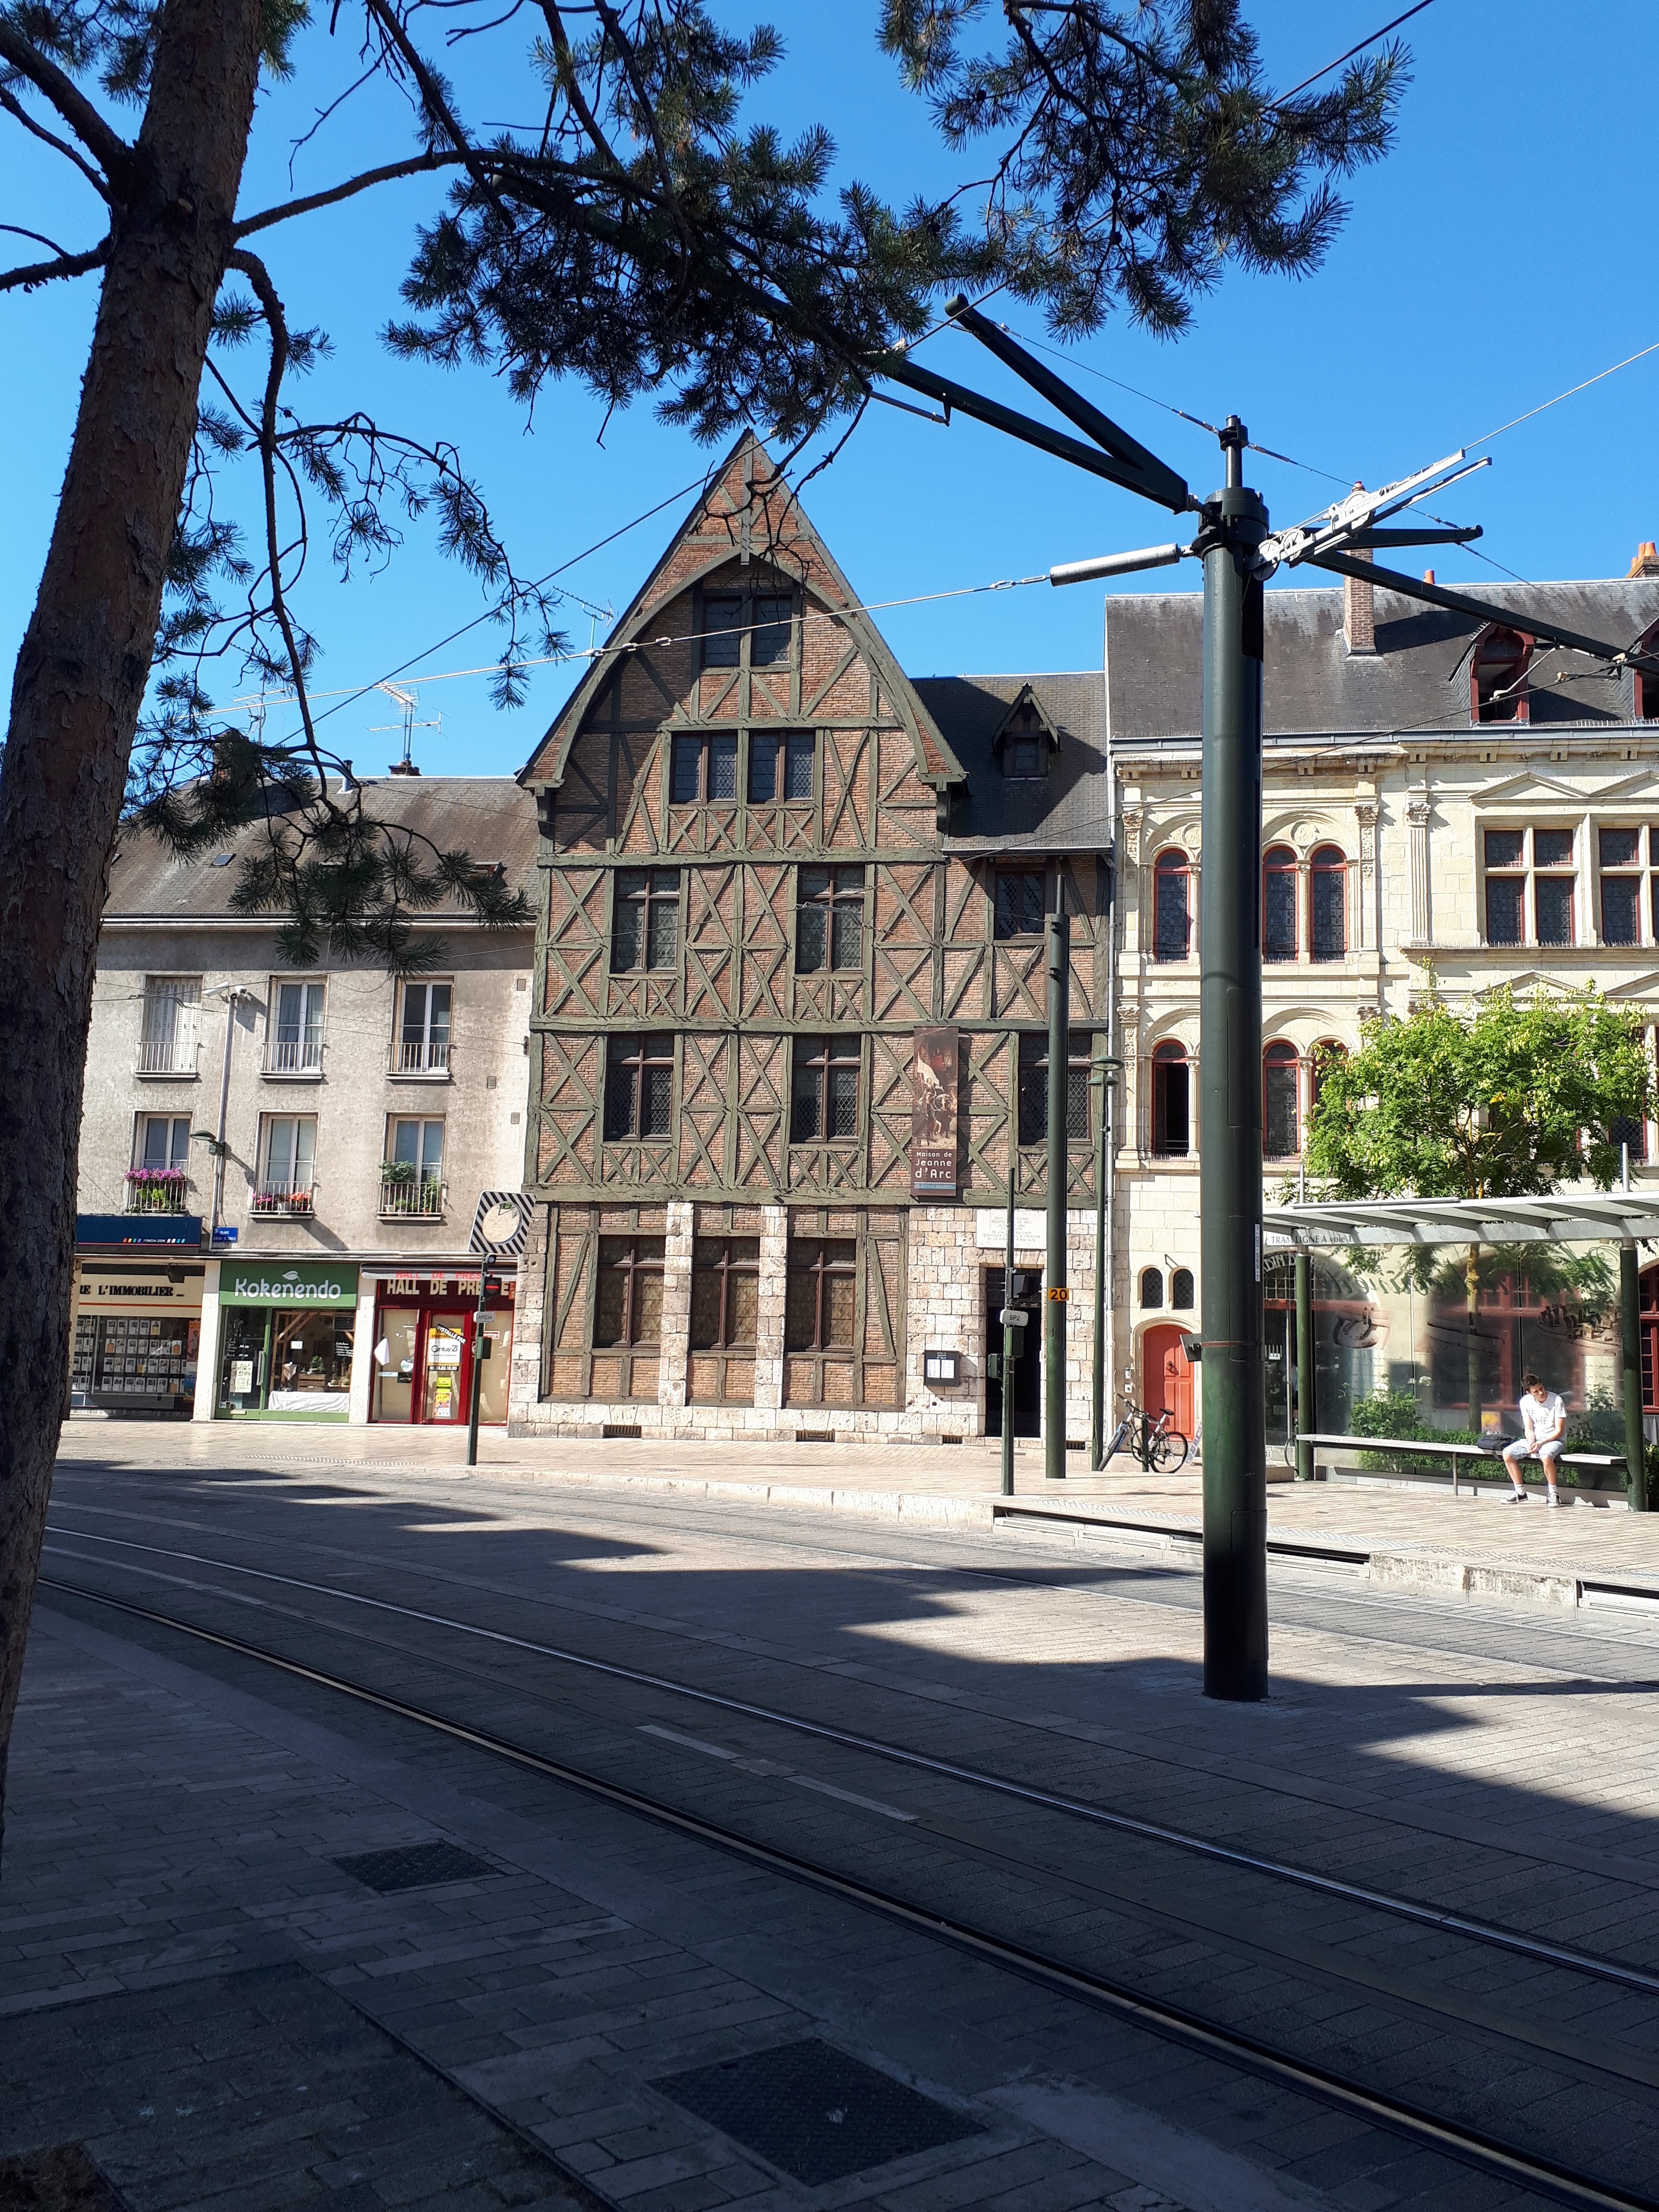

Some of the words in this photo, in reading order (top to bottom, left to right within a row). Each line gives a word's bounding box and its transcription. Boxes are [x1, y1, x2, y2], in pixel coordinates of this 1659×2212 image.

[915, 1167, 951, 1178] d'Arc
[1296, 1235, 1319, 1243] LIGNE
[1330, 1234, 1345, 1243] voie
[98, 1285, 174, 1296] L'IMMOBILIER
[234, 1278, 341, 1299] Kokenendo
[386, 1279, 420, 1295] HALL
[429, 1280, 448, 1296] DE
[1050, 1289, 1068, 1300] 20
